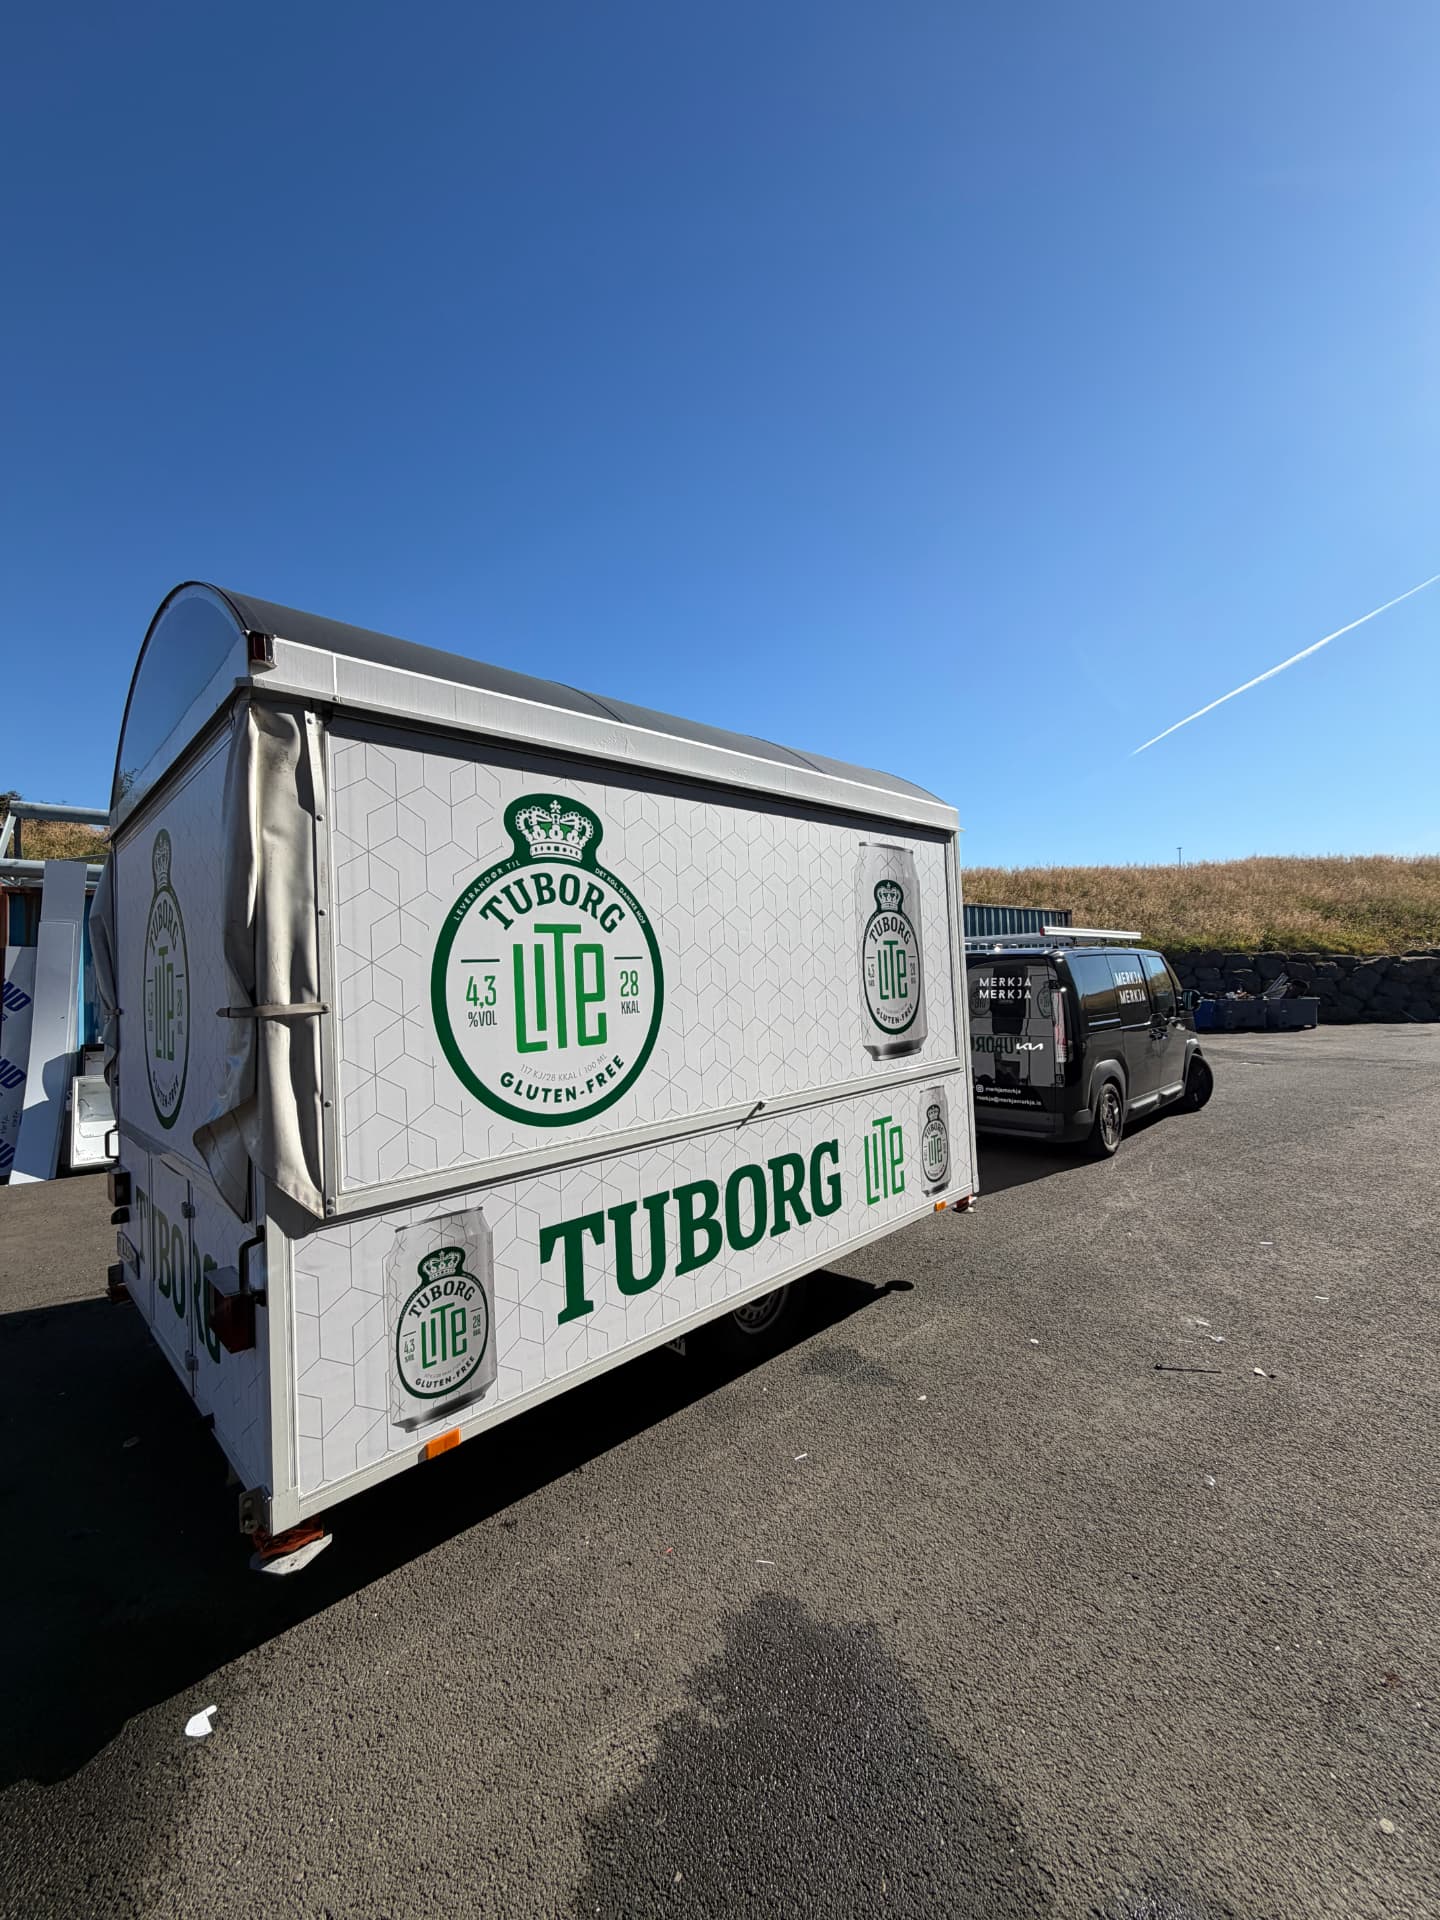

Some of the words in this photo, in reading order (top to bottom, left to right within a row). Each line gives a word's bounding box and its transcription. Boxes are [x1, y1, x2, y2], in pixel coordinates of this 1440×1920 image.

[453, 868, 504, 920] LEVERANDØR
[506, 859, 521, 870] TIL
[479, 872, 626, 935] TUBORG
[869, 916, 912, 945] TUBORG
[465, 975, 498, 1009] 4,3
[619, 970, 640, 997] 28
[979, 977, 1032, 987] MERKJA
[979, 989, 1032, 999] MERKJA
[1119, 988, 1146, 1004] MERKJA
[467, 1010, 498, 1028] %VOL
[620, 999, 641, 1016] KKAL
[499, 1054, 625, 1104] GLUTEN-FREE
[539, 1138, 842, 1325] TUBORG
[408, 1280, 476, 1319] TUBORG
[415, 1355, 475, 1389] GLUTEN-FREE
